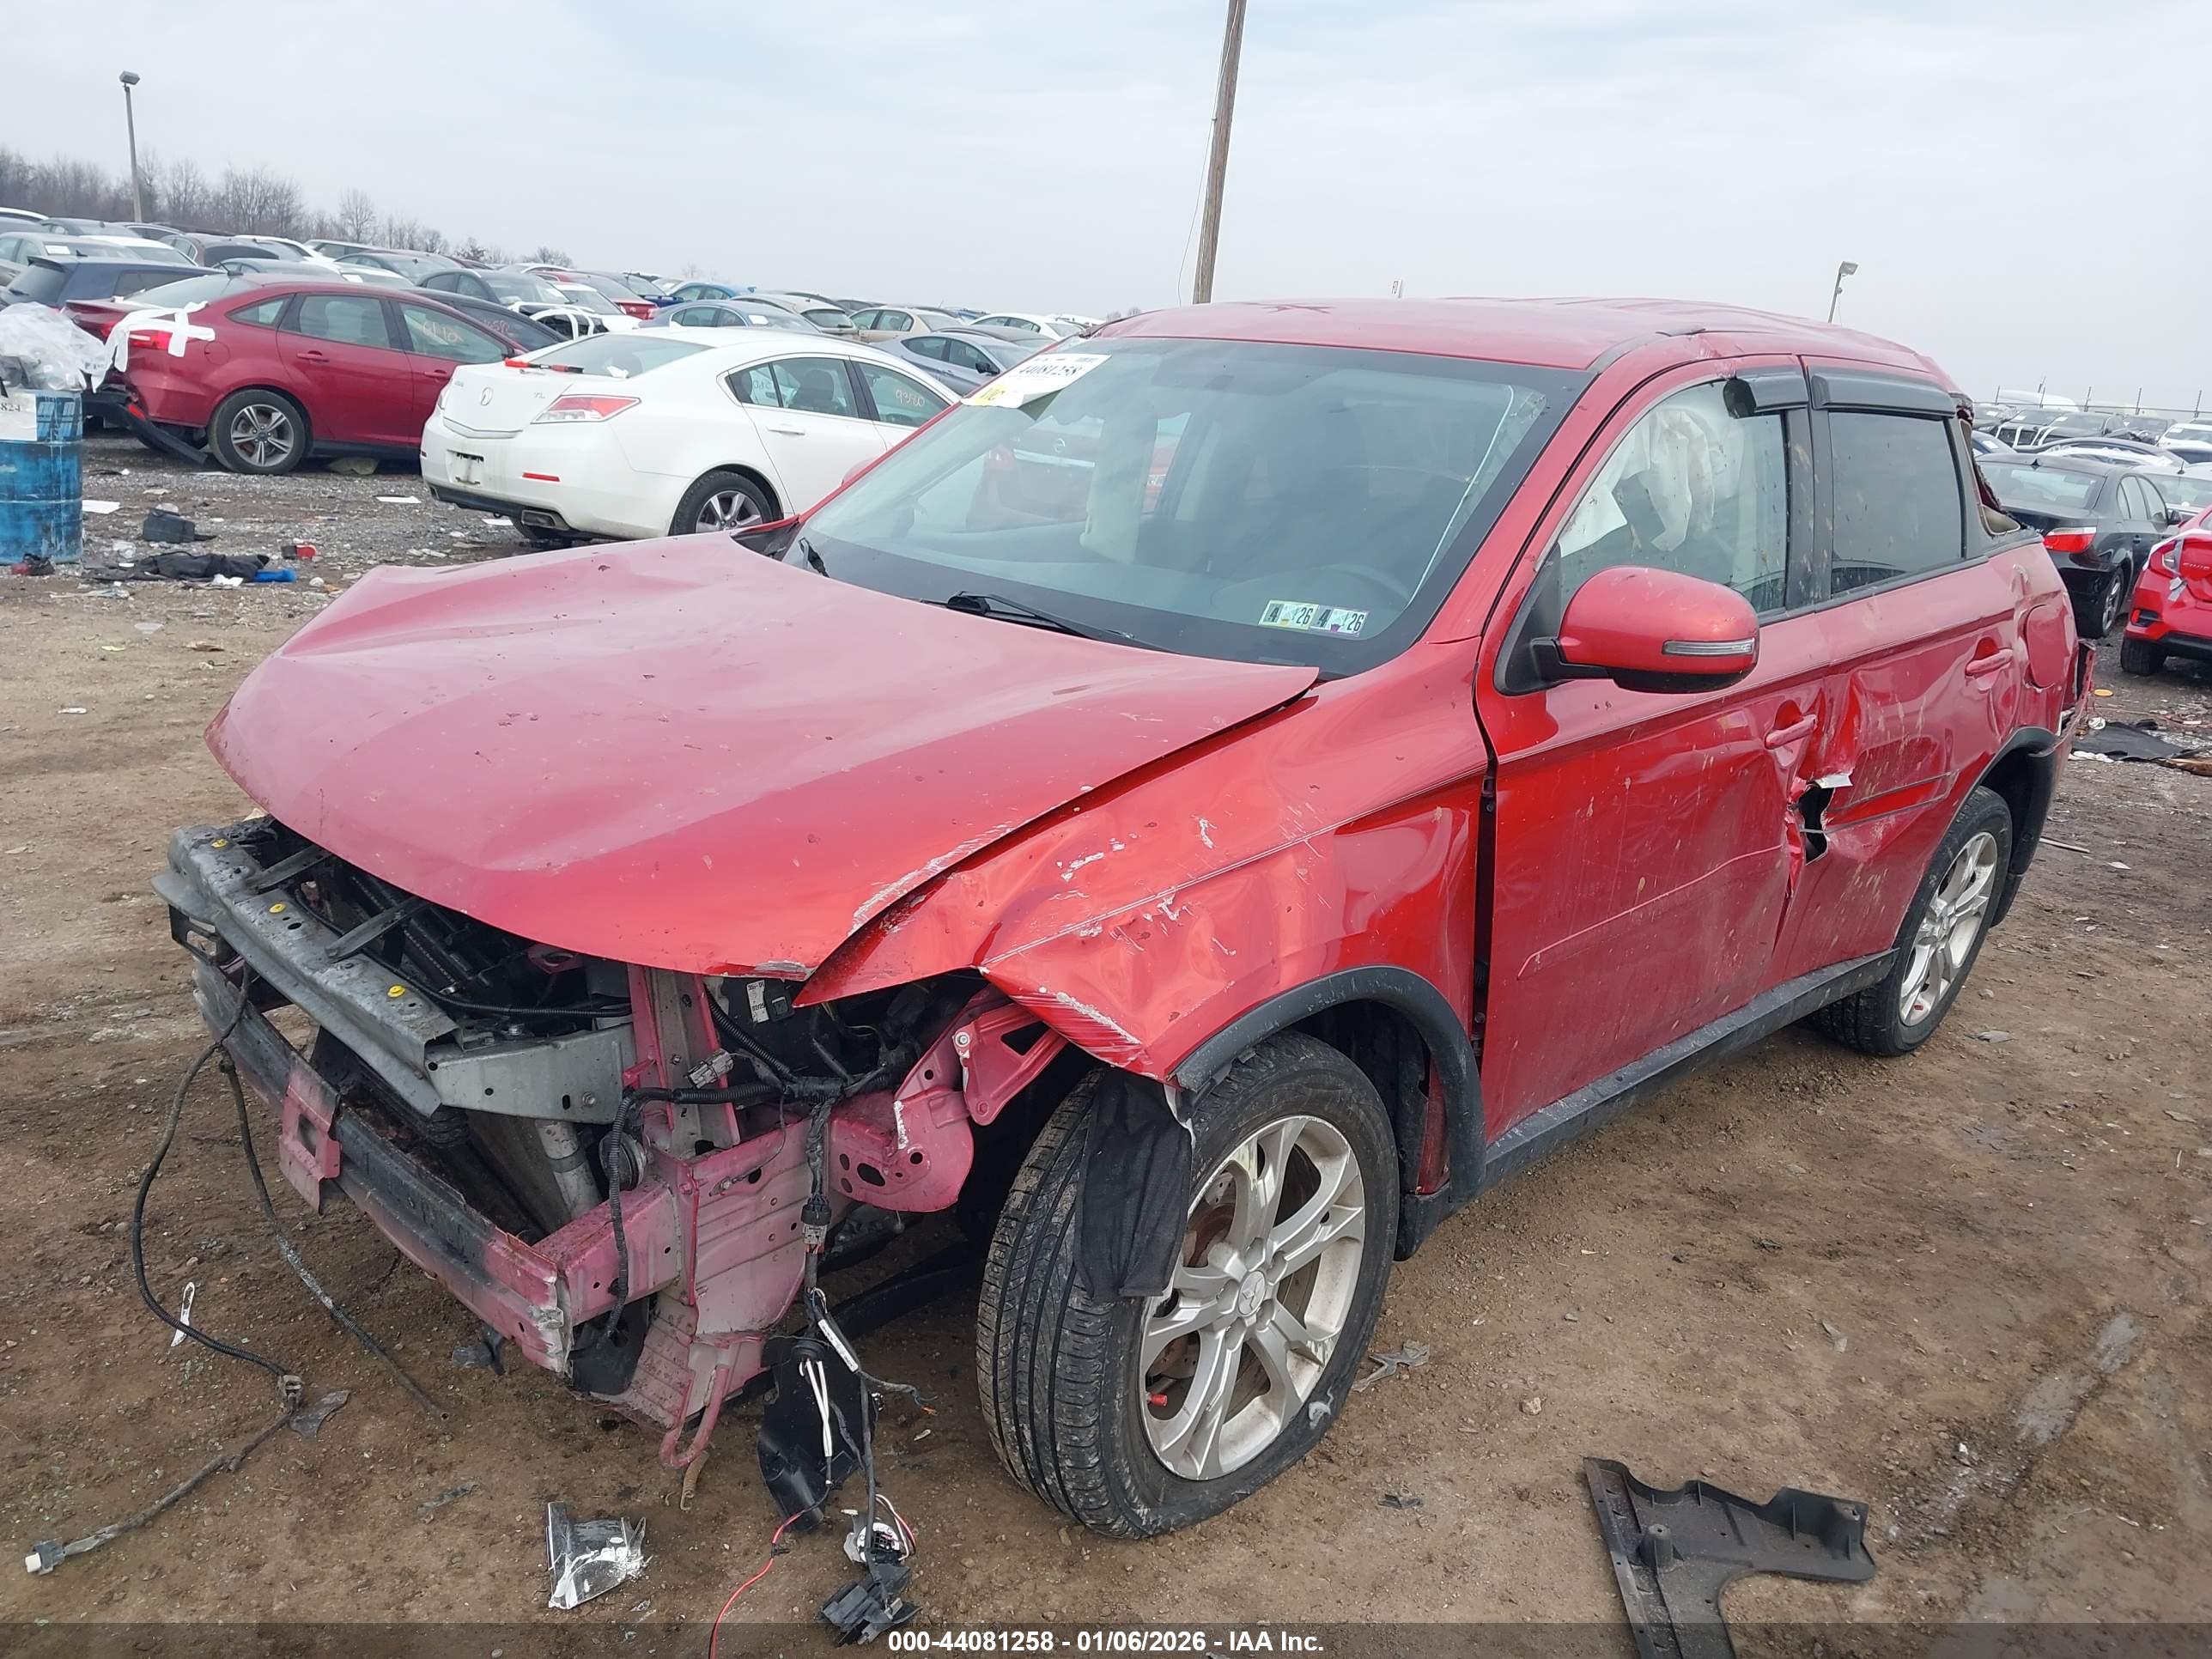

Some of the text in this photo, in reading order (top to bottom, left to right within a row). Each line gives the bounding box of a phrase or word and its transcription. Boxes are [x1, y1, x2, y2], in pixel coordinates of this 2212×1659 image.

[1268, 606, 1314, 626] 4 26
[1316, 608, 1364, 632] 4 26
